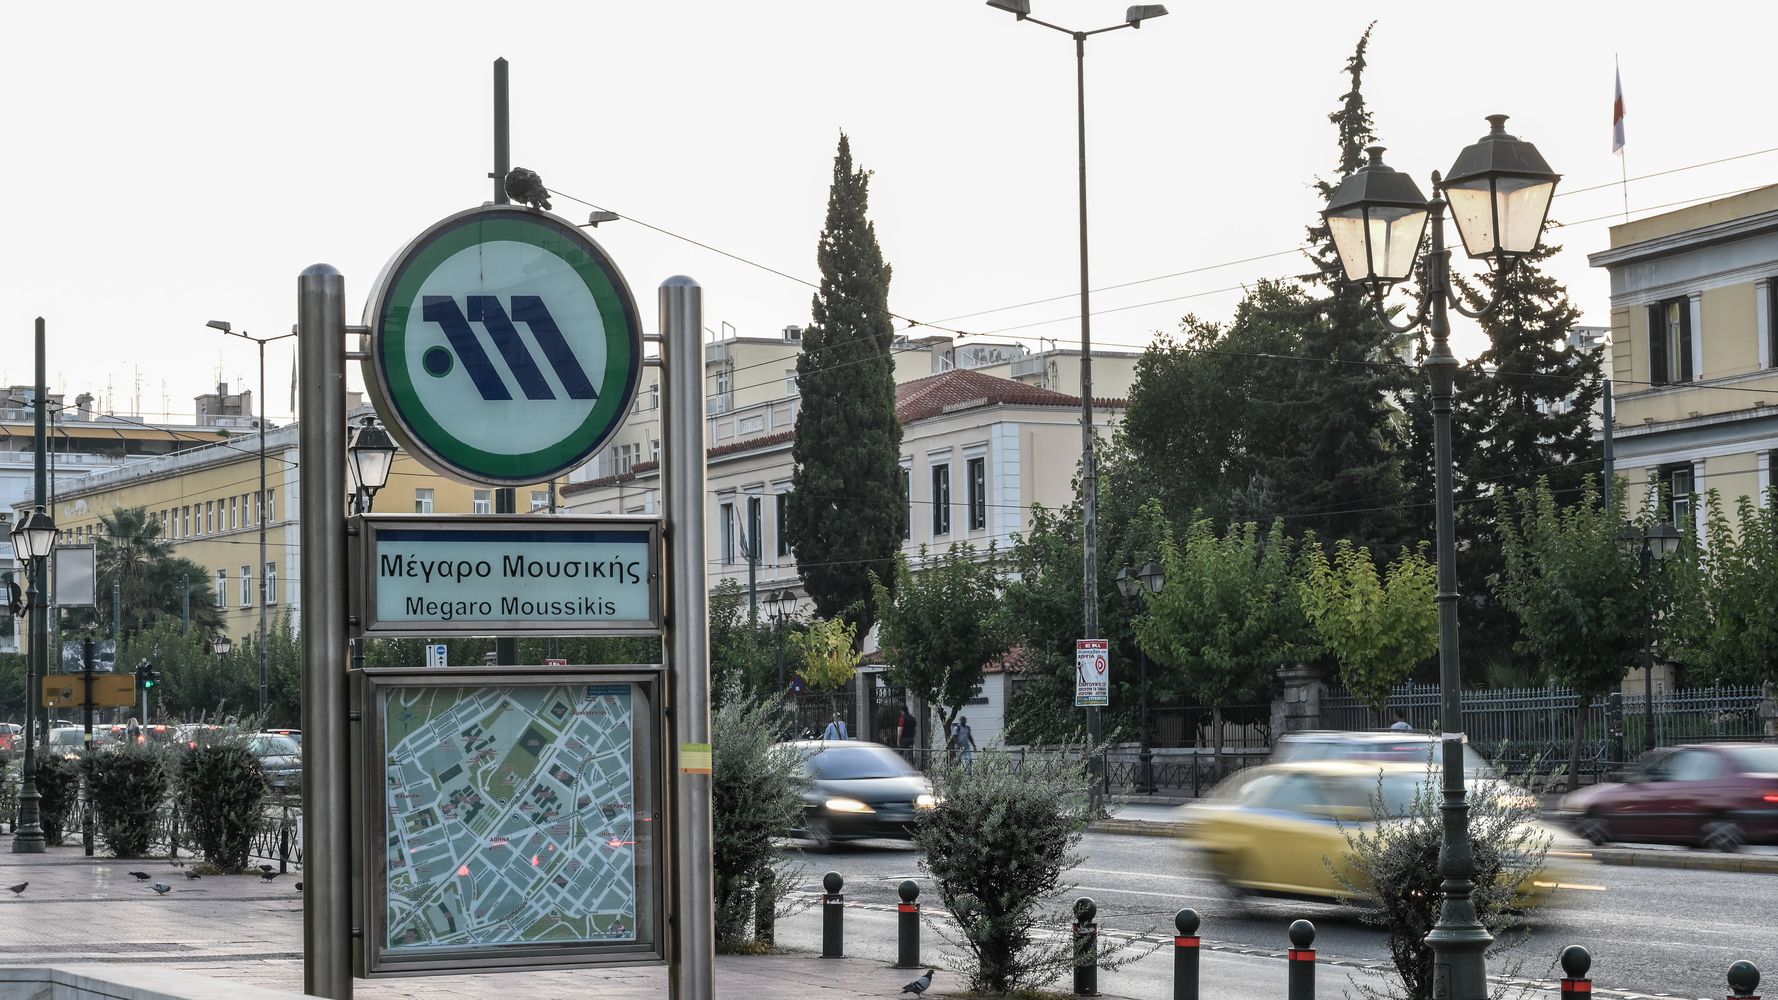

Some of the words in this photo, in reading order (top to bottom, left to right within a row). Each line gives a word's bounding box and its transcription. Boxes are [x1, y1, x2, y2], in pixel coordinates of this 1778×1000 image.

[381, 553, 492, 584] Μέγαρο
[503, 554, 641, 584] Μουσικής
[405, 596, 492, 621] Megaro
[500, 596, 616, 616] Moussikis
